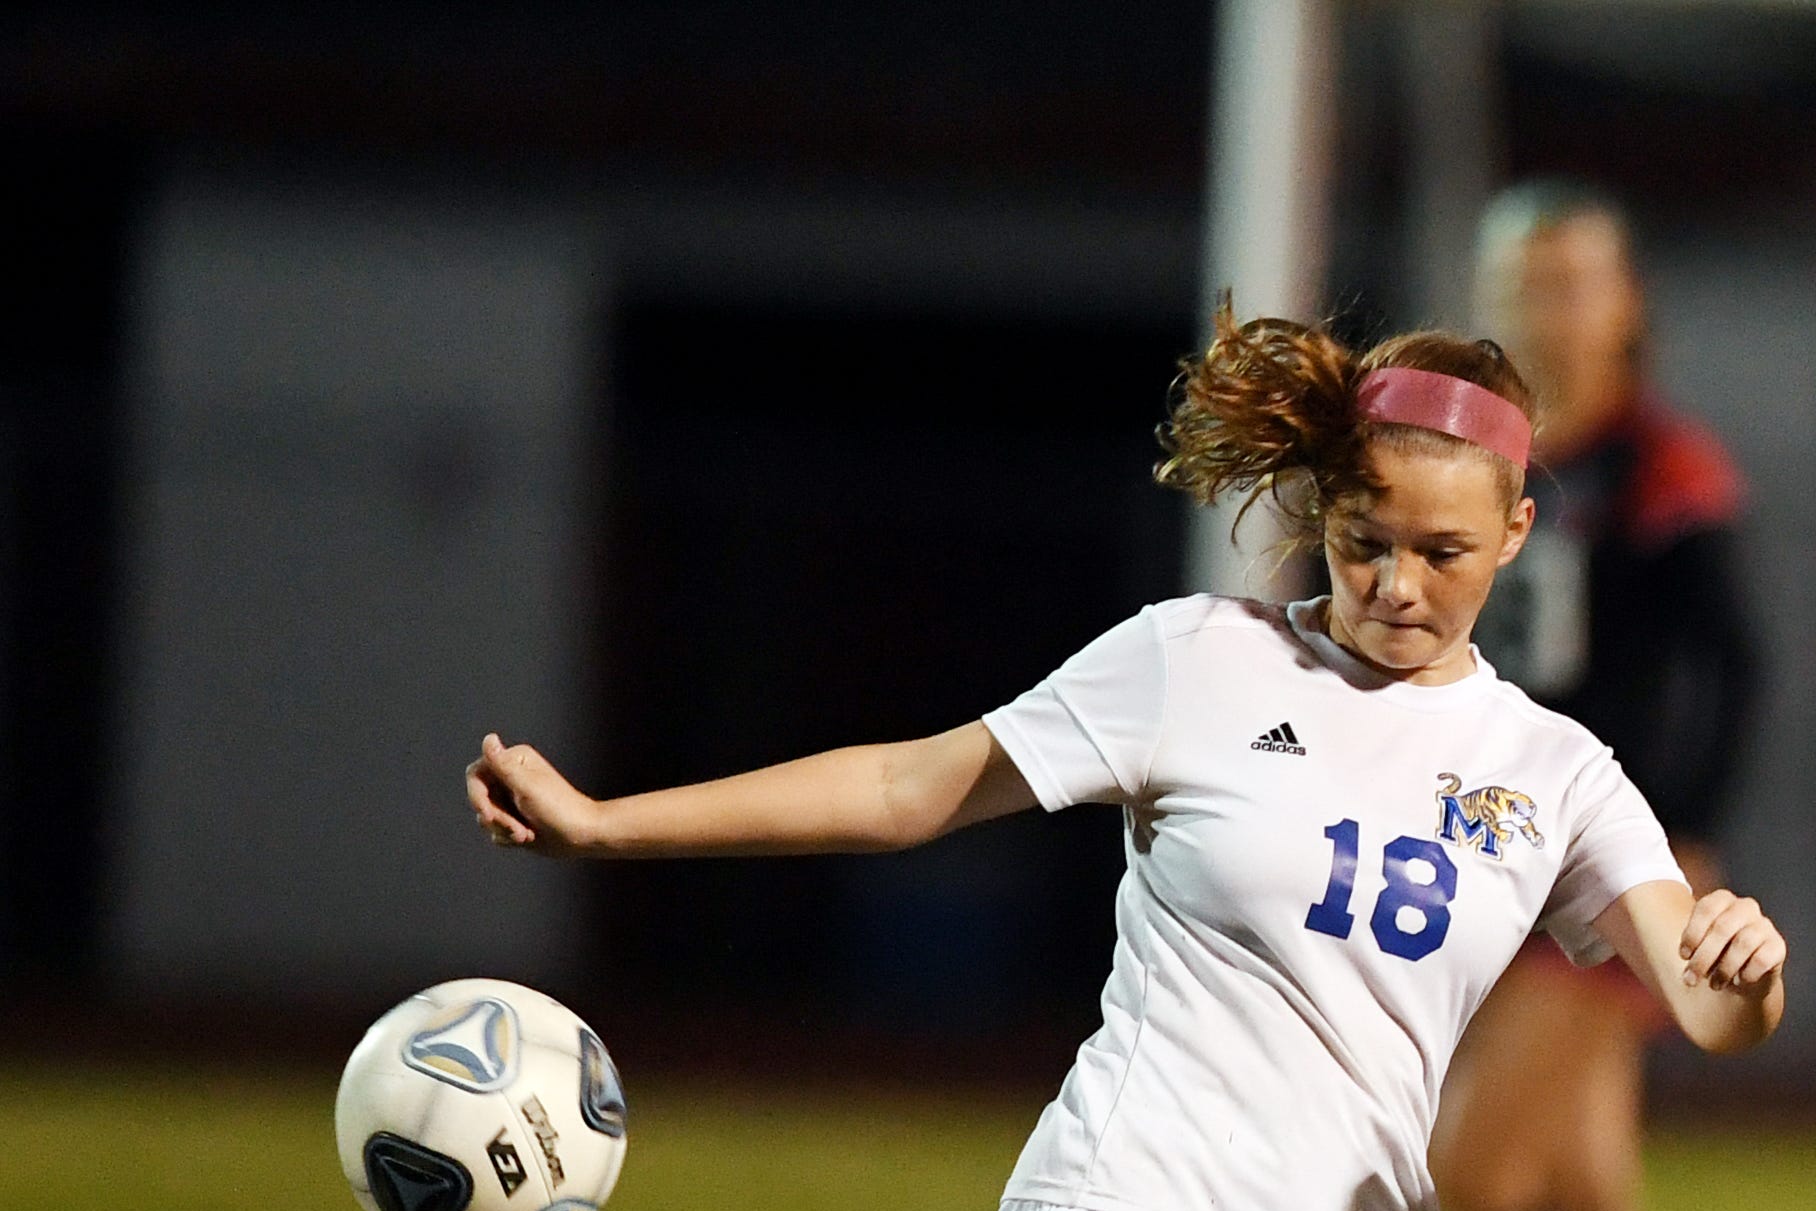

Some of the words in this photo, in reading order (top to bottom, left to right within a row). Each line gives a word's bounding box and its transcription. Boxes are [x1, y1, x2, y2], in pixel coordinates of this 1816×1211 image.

[1250, 740, 1307, 756] adidas
[1434, 790, 1504, 861] M
[1303, 817, 1458, 962] 18
